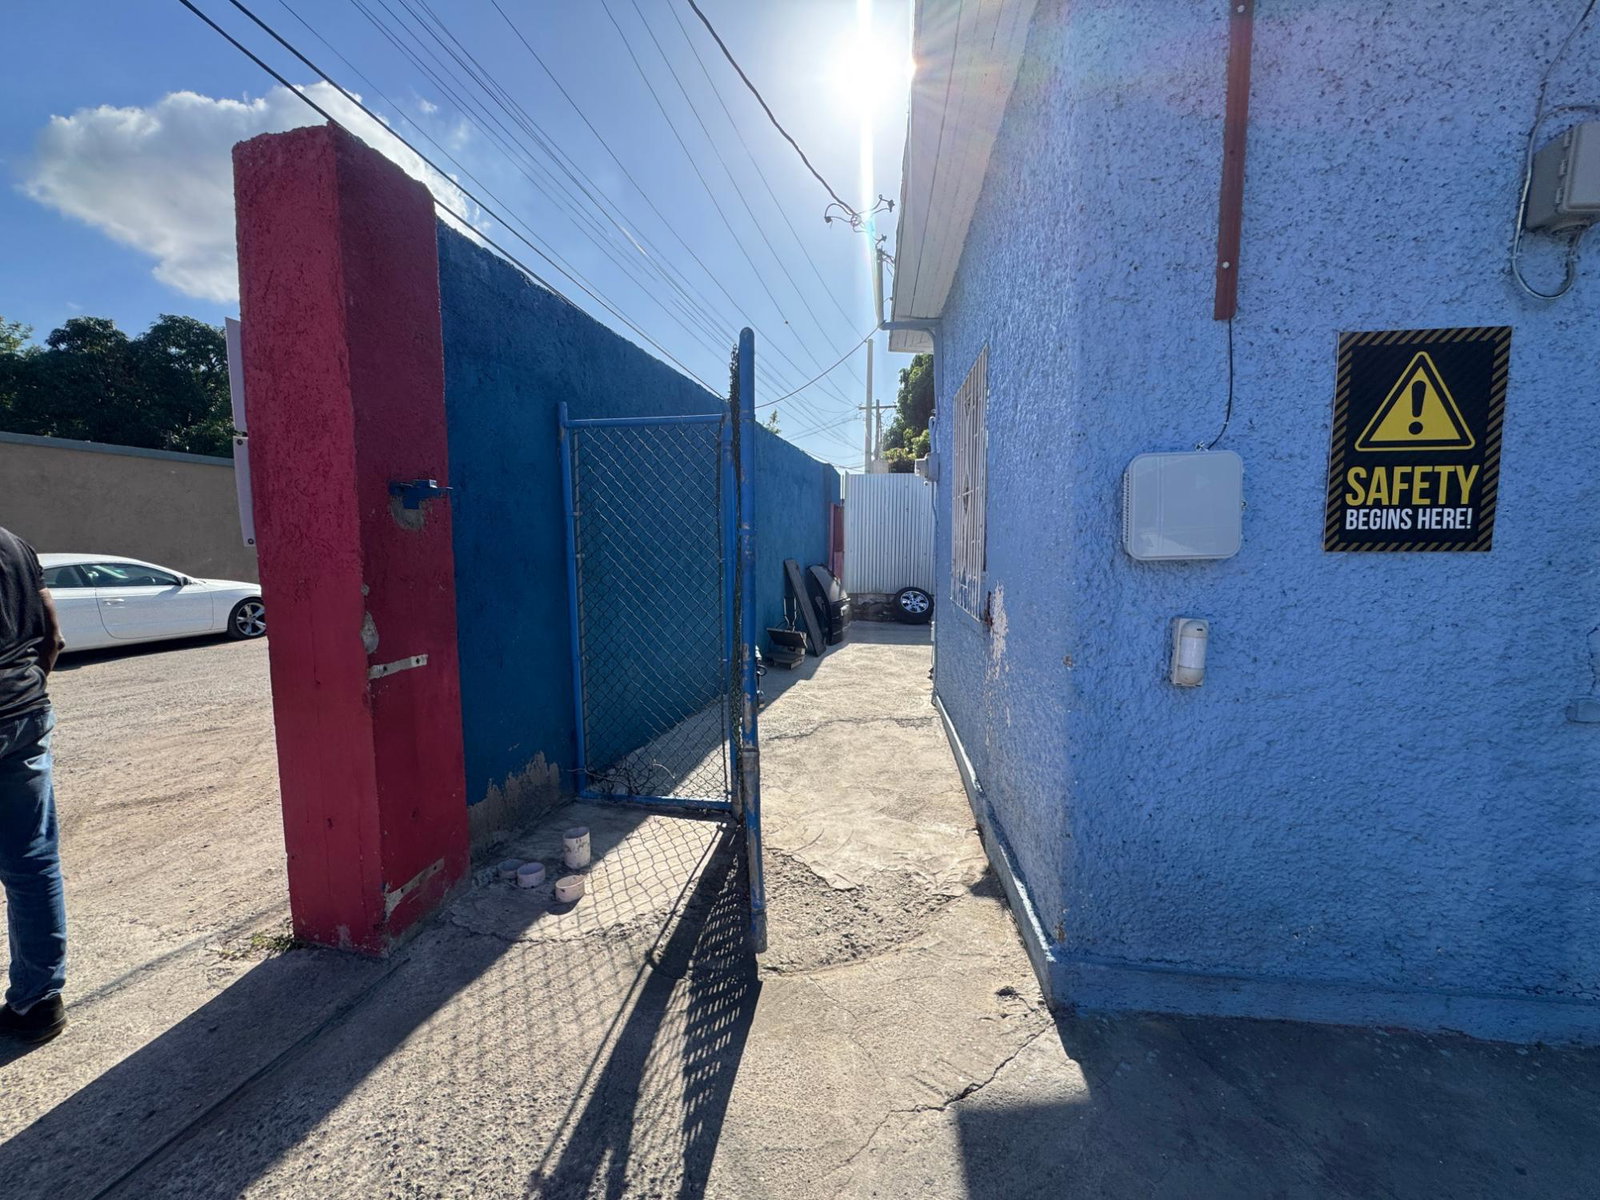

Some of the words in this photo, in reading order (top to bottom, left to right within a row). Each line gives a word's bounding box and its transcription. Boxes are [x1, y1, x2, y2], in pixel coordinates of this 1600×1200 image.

[1345, 465, 1480, 506] SAFETY
[1345, 508, 1412, 530] BEGINS
[1417, 508, 1473, 530] HERE!
